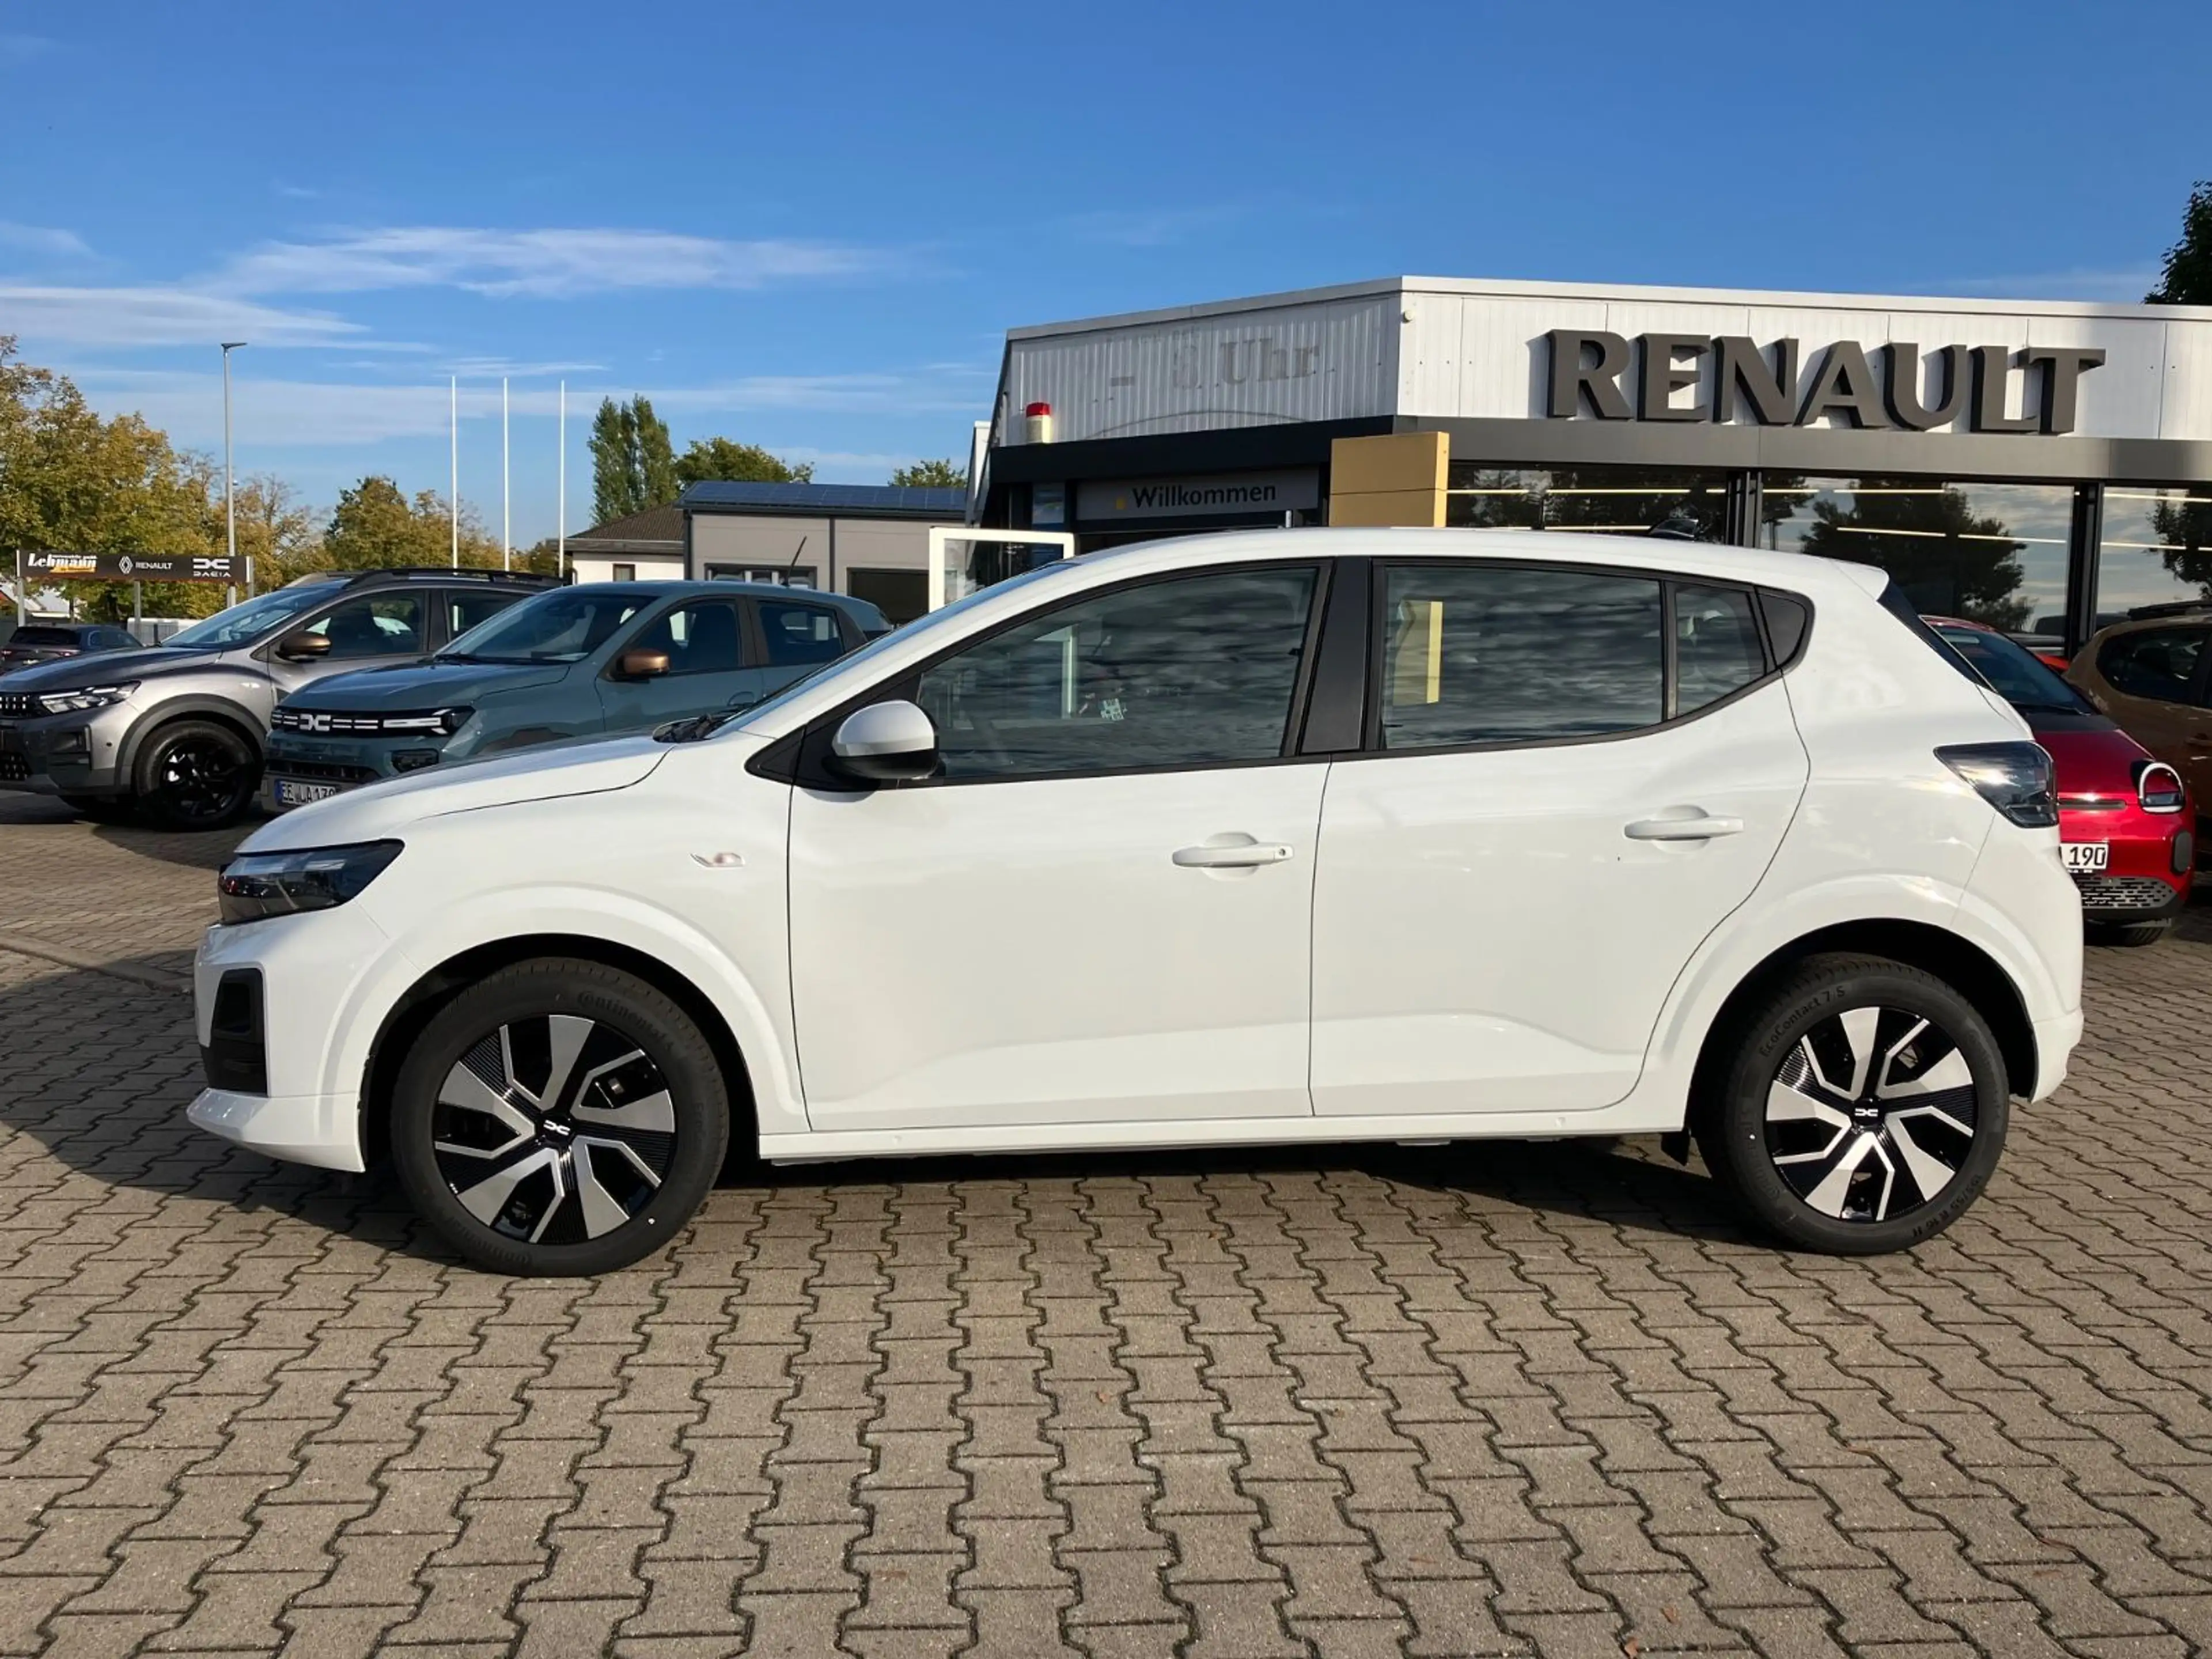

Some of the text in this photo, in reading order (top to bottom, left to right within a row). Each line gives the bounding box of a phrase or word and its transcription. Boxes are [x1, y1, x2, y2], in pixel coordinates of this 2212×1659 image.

[1220, 338, 1320, 385] Uhr
[1546, 328, 2106, 435] RENAULT
[1132, 485, 1277, 508] Willkommen
[28, 552, 97, 567] Lehmann
[135, 562, 173, 570] RENAULT
[2068, 846, 2107, 866] 190
[1759, 985, 1846, 1058] EcoContact 7 S
